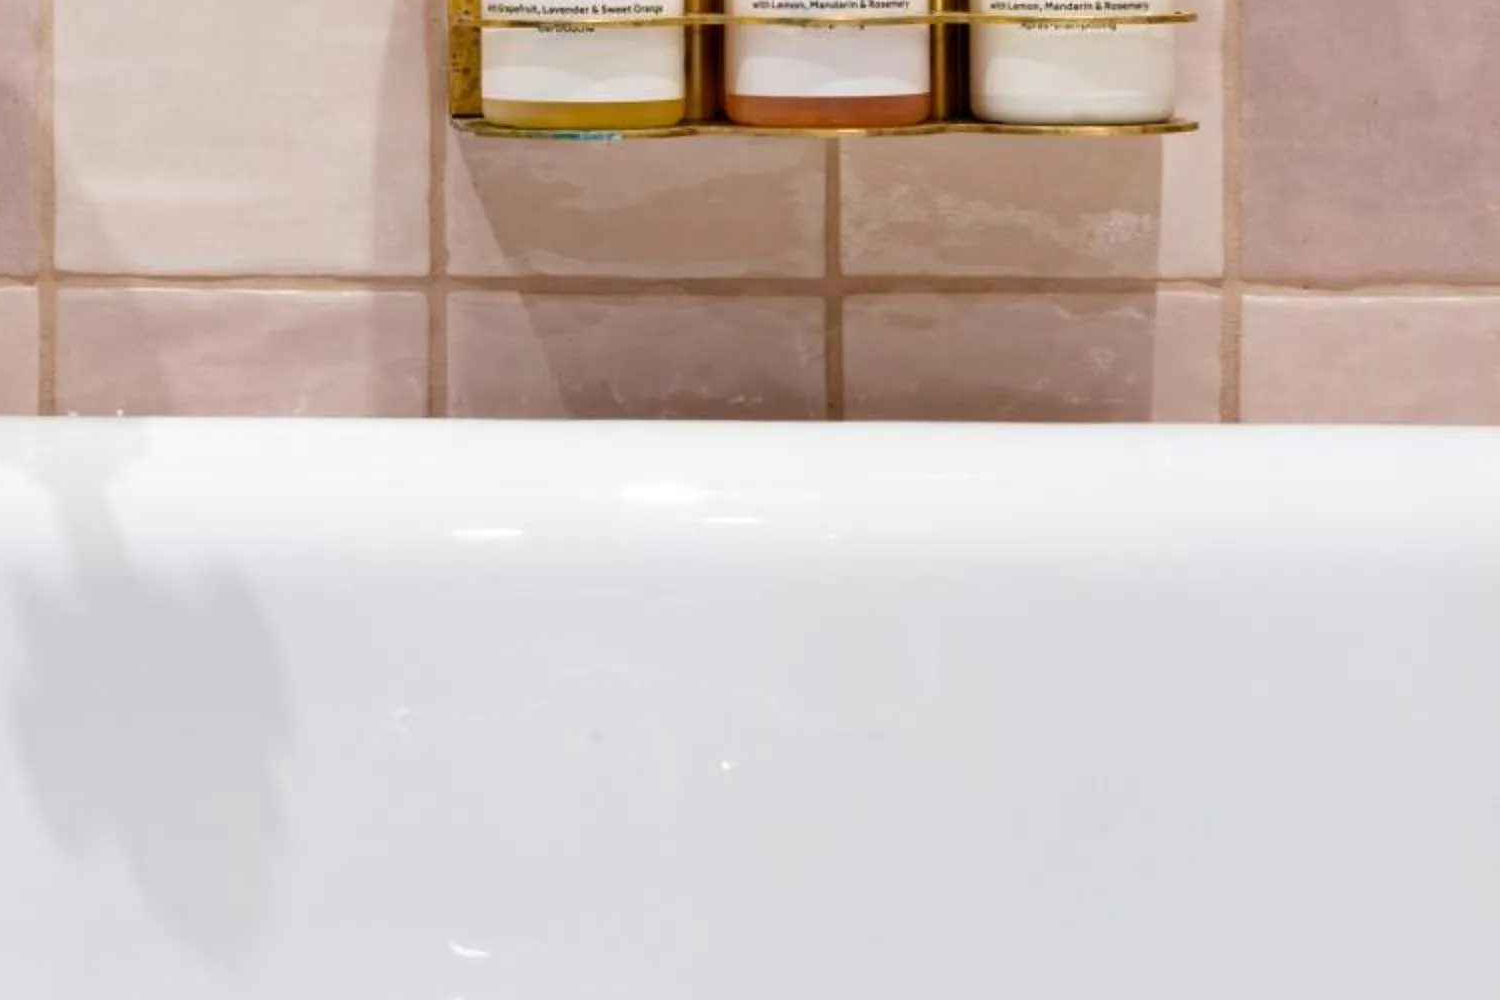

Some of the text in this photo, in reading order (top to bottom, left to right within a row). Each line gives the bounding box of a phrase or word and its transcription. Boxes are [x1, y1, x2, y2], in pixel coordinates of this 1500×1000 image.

[542, 4, 589, 14] Lavender
[591, 4, 599, 14] &
[601, 4, 632, 14] Sweet
[633, 3, 664, 16] Orange
[771, 0, 806, 11] Lemon,
[809, 0, 859, 9] Mandarin
[860, 0, 867, 9] &
[868, 0, 910, 10] Rosemary
[1007, 1, 1043, 13] Lemon,
[1045, 1, 1093, 11] Mandarin
[1094, 1, 1102, 11] &
[1104, 1, 1149, 12] Rosemary
